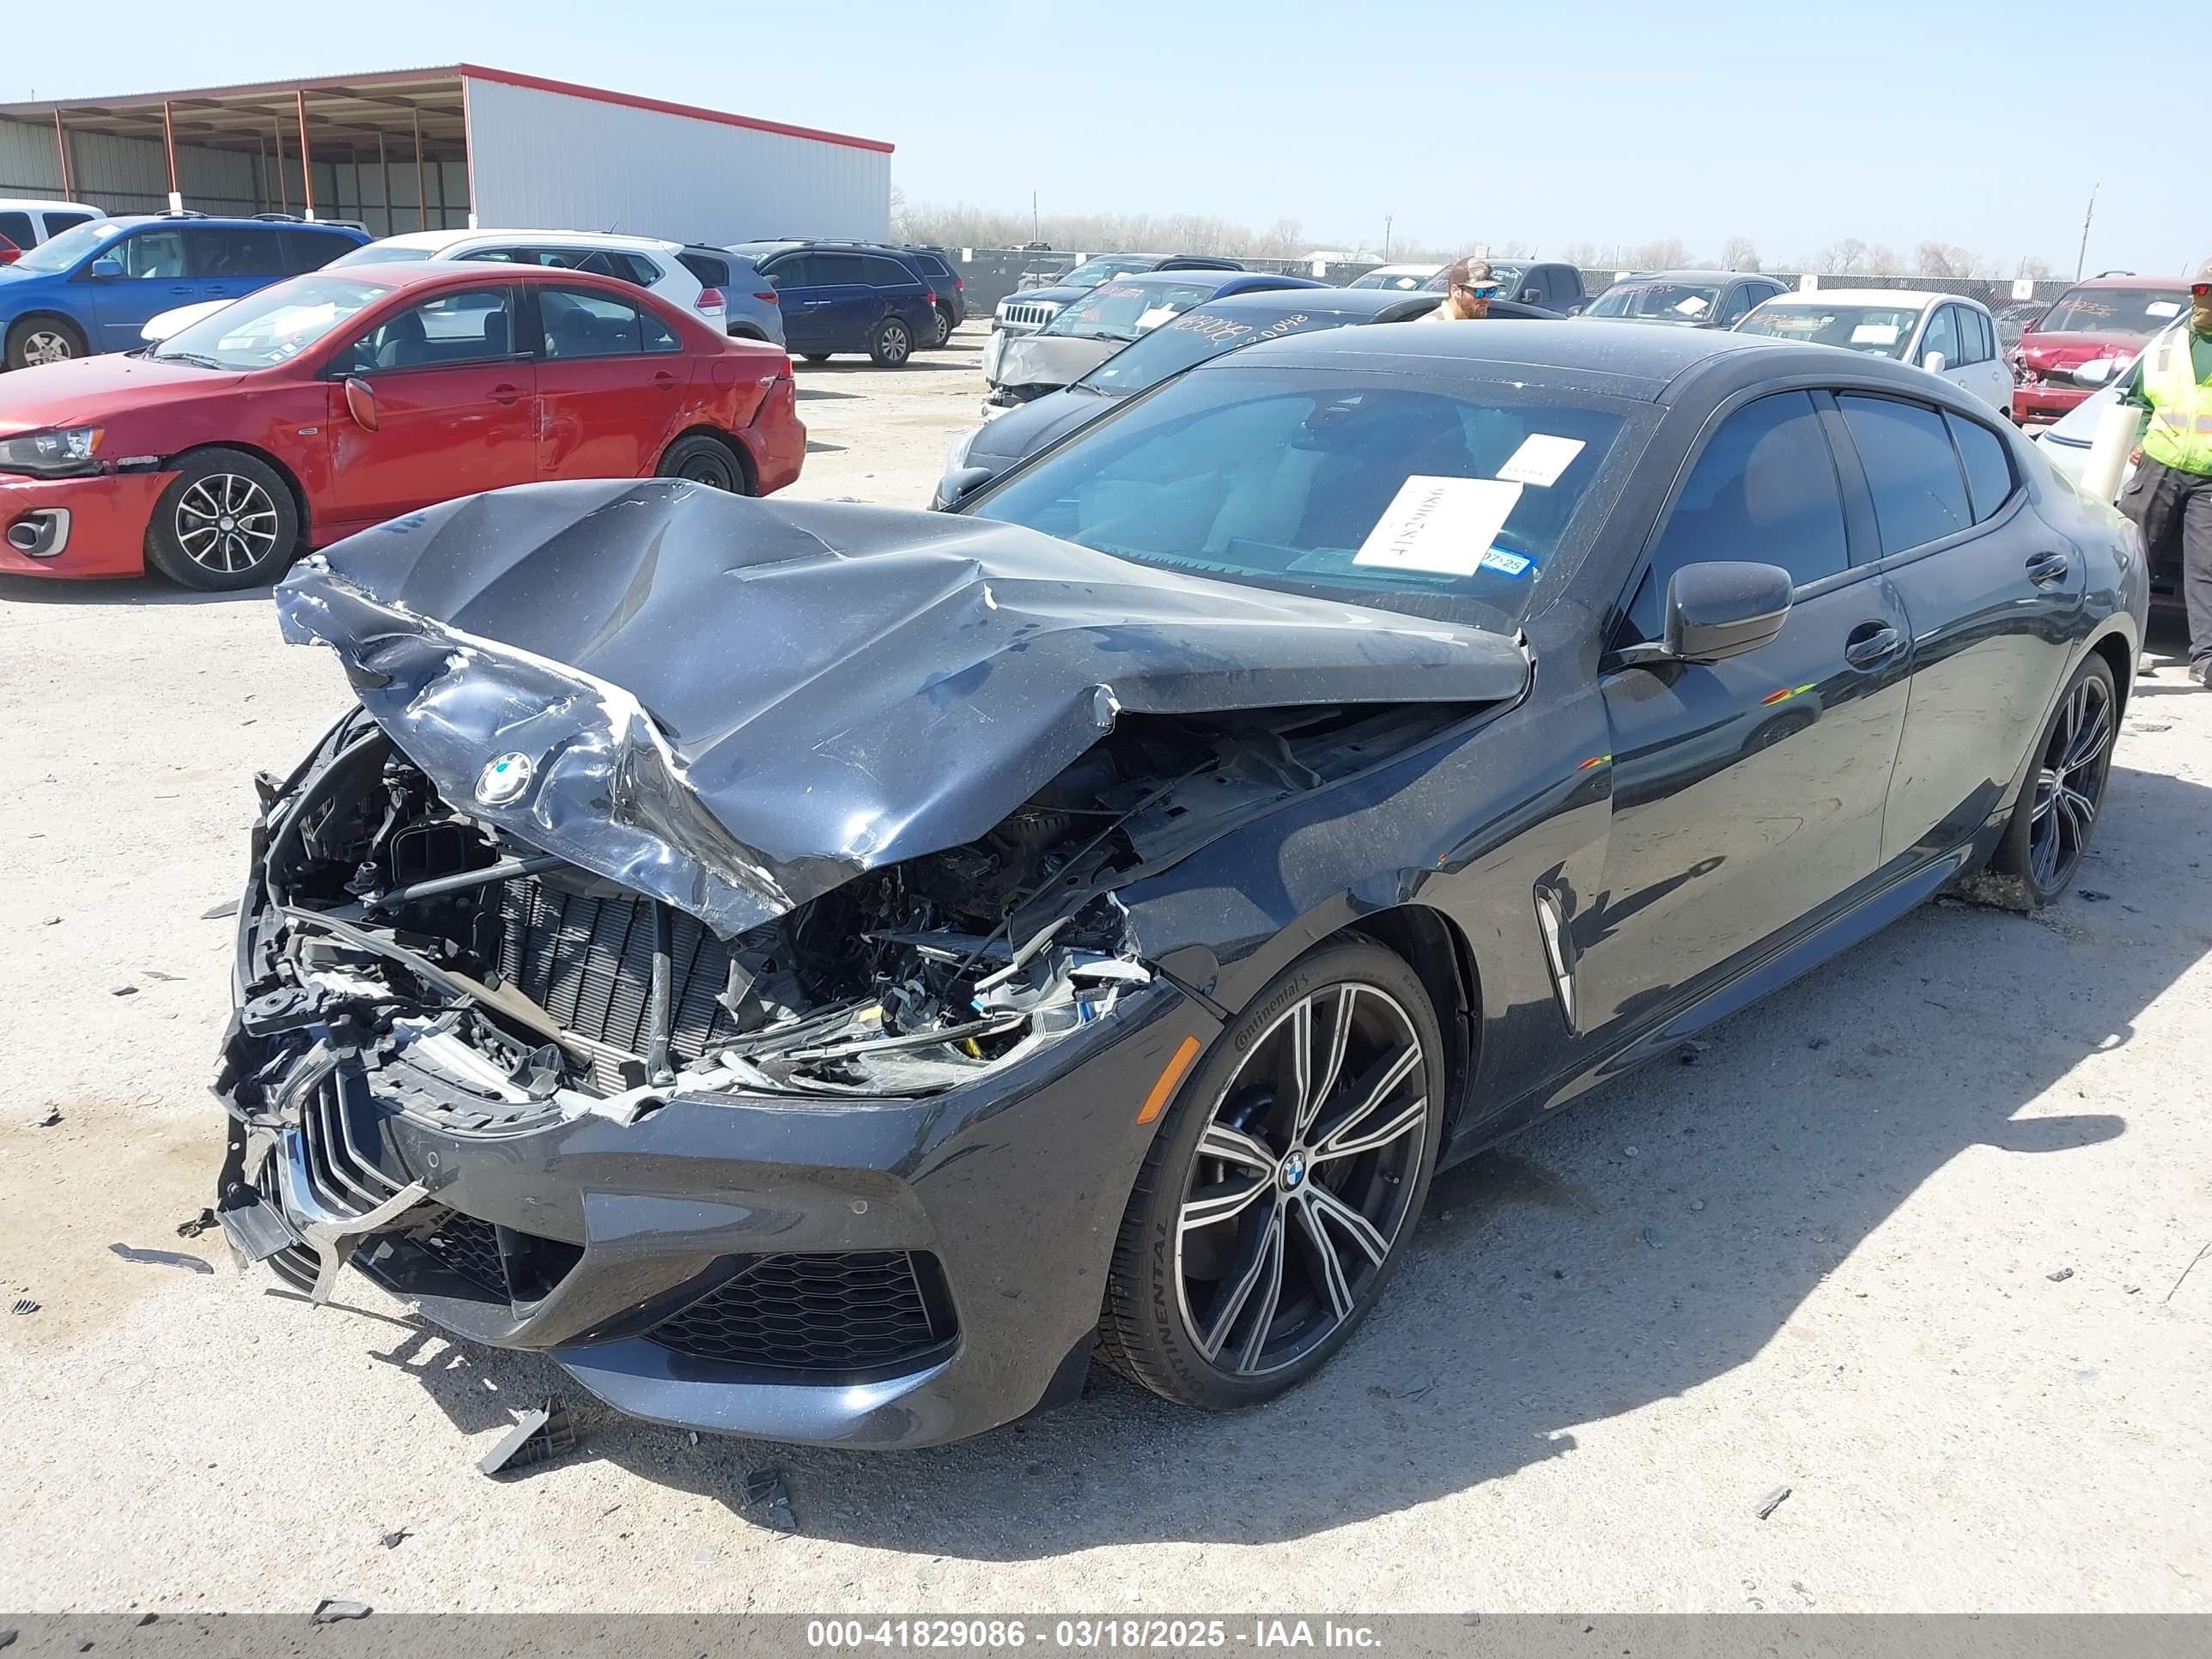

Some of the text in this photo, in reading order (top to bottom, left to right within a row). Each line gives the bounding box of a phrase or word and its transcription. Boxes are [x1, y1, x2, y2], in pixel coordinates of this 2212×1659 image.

[1234, 977, 1301, 1053] Continental
[1285, 1153, 1305, 1171] BMW
[1152, 1218, 1206, 1397] ONTINENTAL
